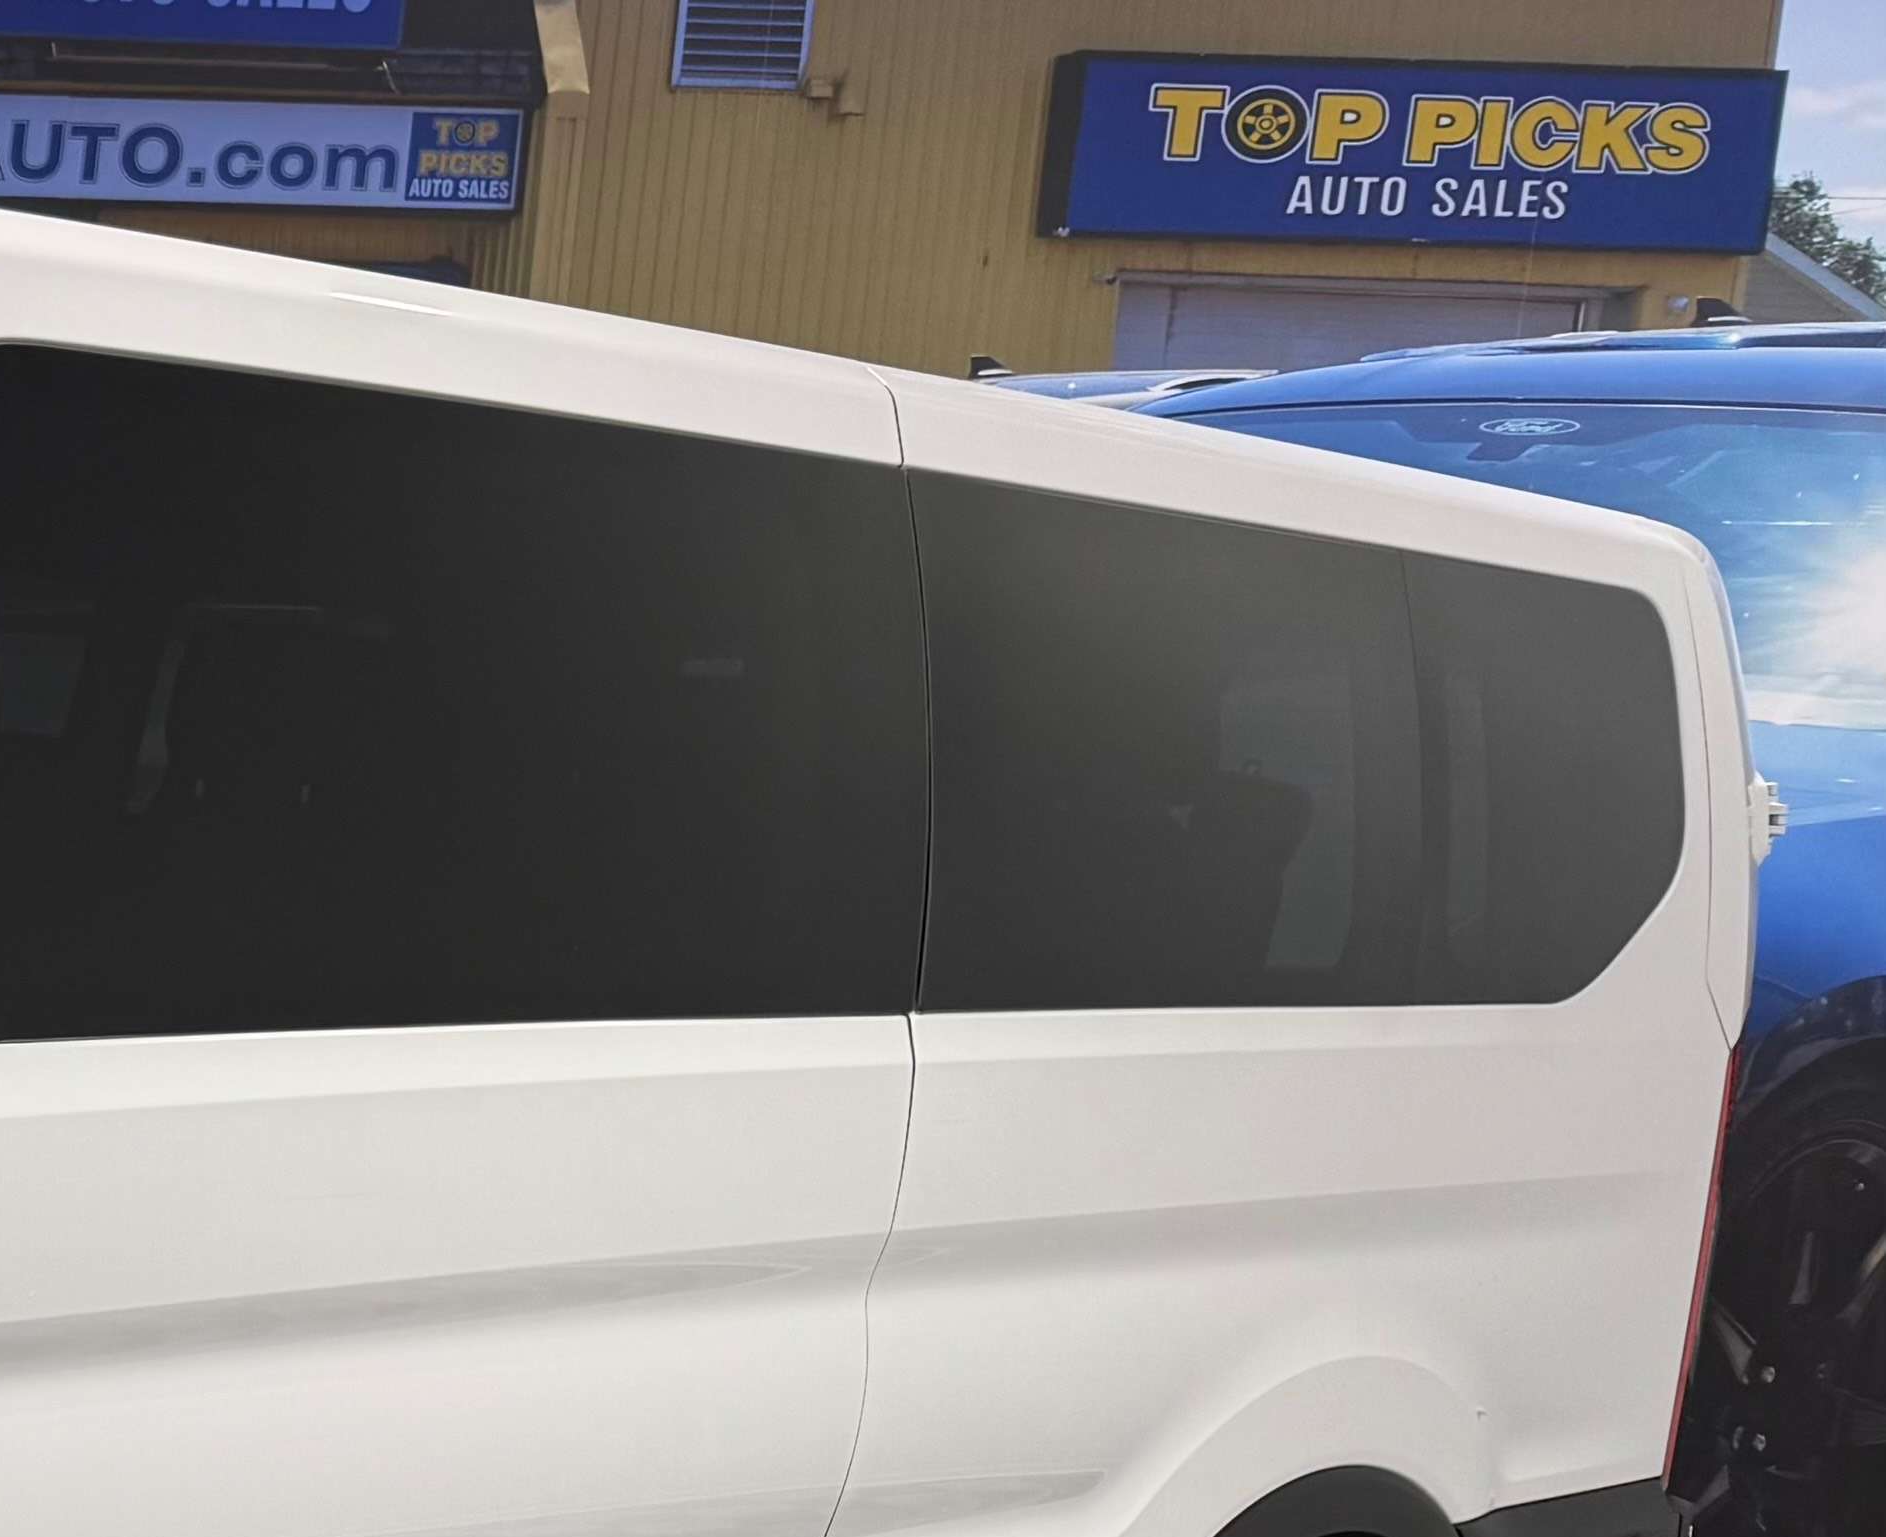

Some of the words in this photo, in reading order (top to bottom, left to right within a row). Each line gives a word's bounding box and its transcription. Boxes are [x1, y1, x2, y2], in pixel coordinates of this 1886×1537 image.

[433, 118, 499, 147] TOP
[1149, 83, 1391, 165] TOP
[1402, 93, 1710, 175] PICKS
[419, 150, 508, 177] PICKS
[409, 178, 454, 198] AUTO
[458, 179, 509, 199] SALES
[1286, 175, 1407, 217] AUTO
[1431, 178, 1569, 220] SALES
